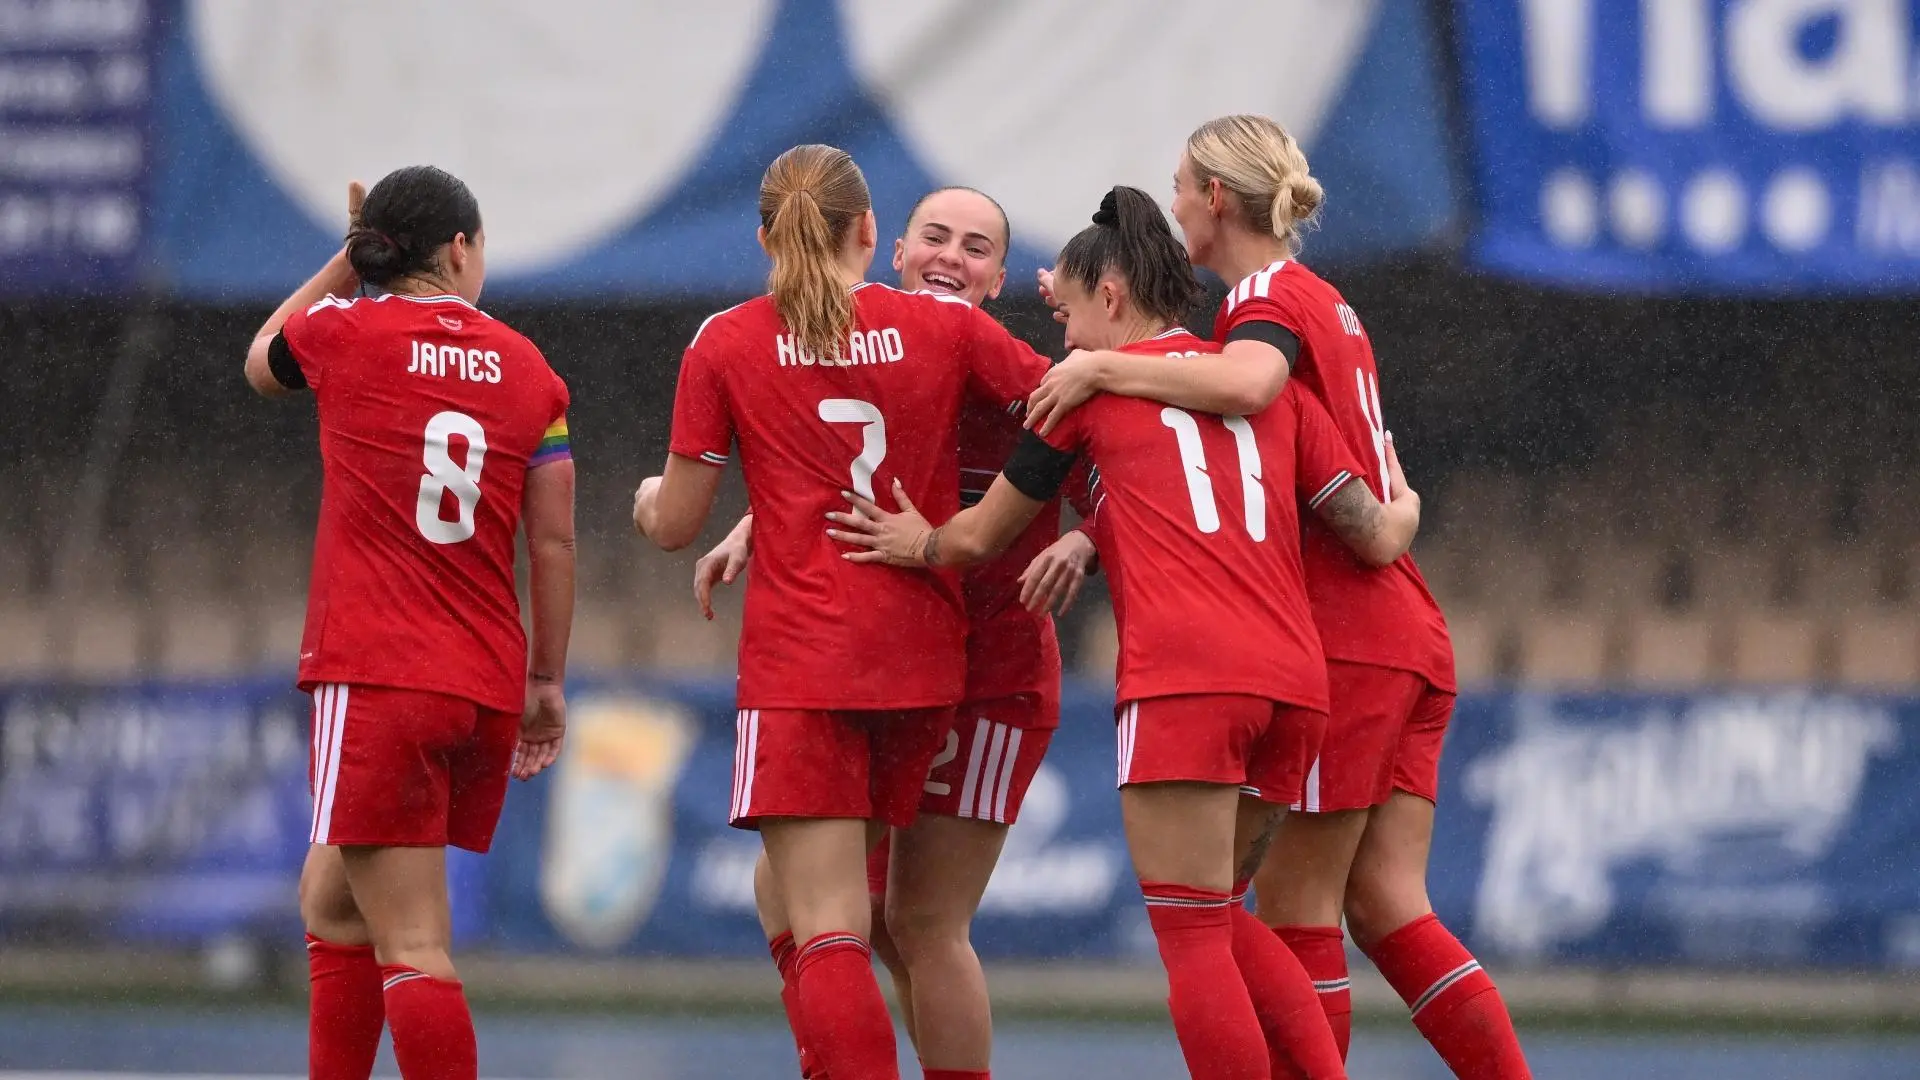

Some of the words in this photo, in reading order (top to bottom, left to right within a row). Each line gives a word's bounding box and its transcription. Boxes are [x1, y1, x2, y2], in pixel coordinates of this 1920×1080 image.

[407, 340, 502, 384] JAMES
[416, 411, 488, 545] 8
[818, 398, 886, 515] 7
[1160, 407, 1266, 543] 11
